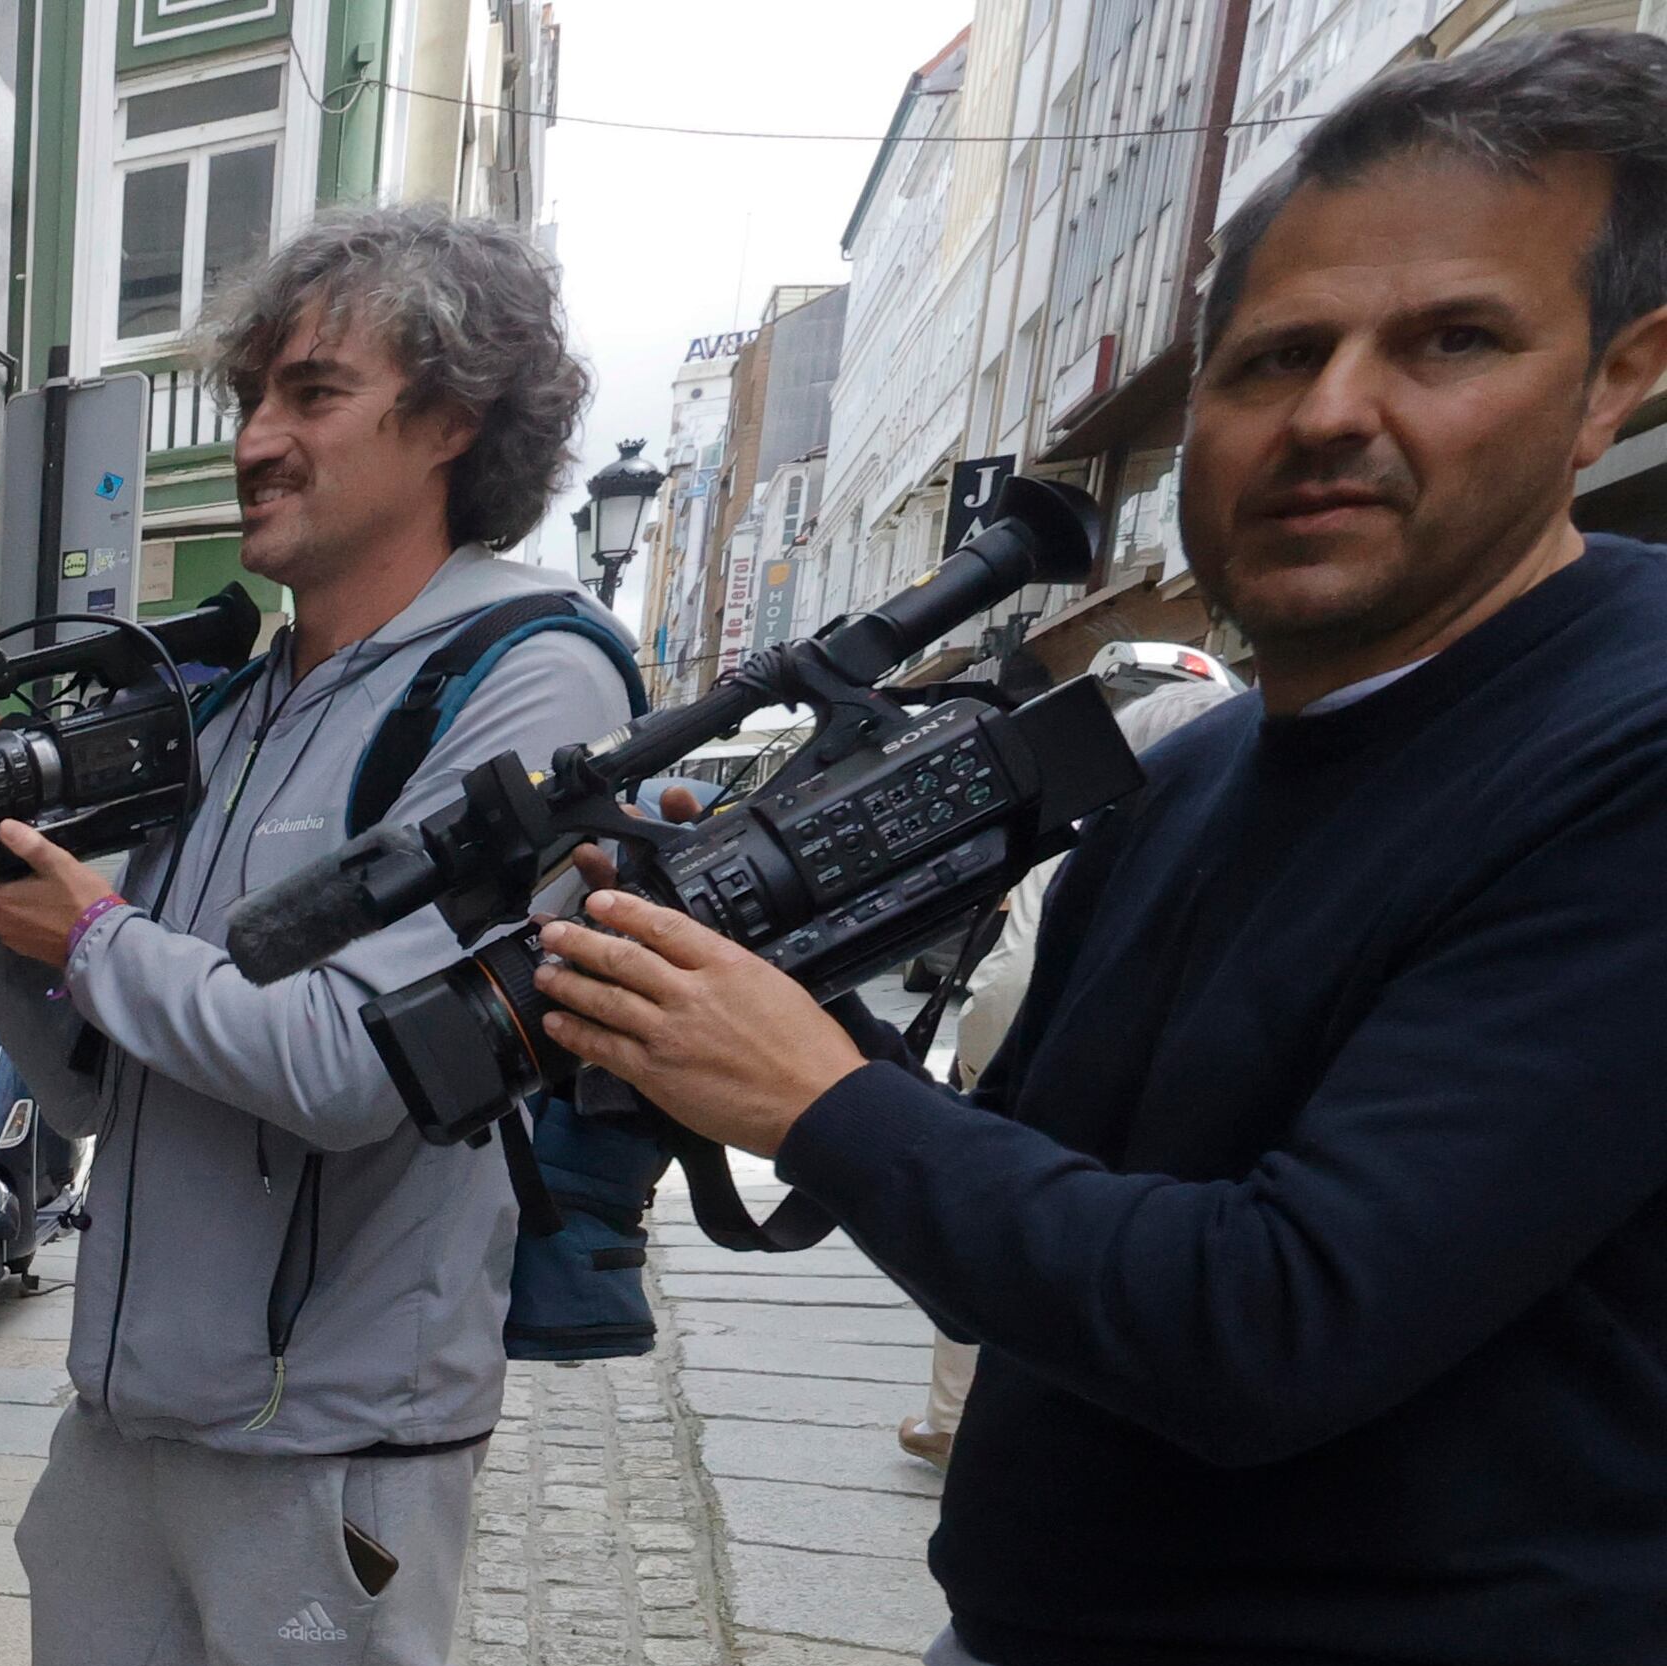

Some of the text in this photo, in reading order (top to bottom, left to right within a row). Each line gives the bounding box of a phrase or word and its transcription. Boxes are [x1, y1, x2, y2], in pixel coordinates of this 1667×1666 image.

[955, 466, 1001, 551] JA
[727, 557, 751, 609] Ferrol
[763, 590, 785, 648] HOTE
[882, 709, 957, 754] SONY
[264, 814, 325, 834] Columbia
[278, 1625, 348, 1641] adidas
